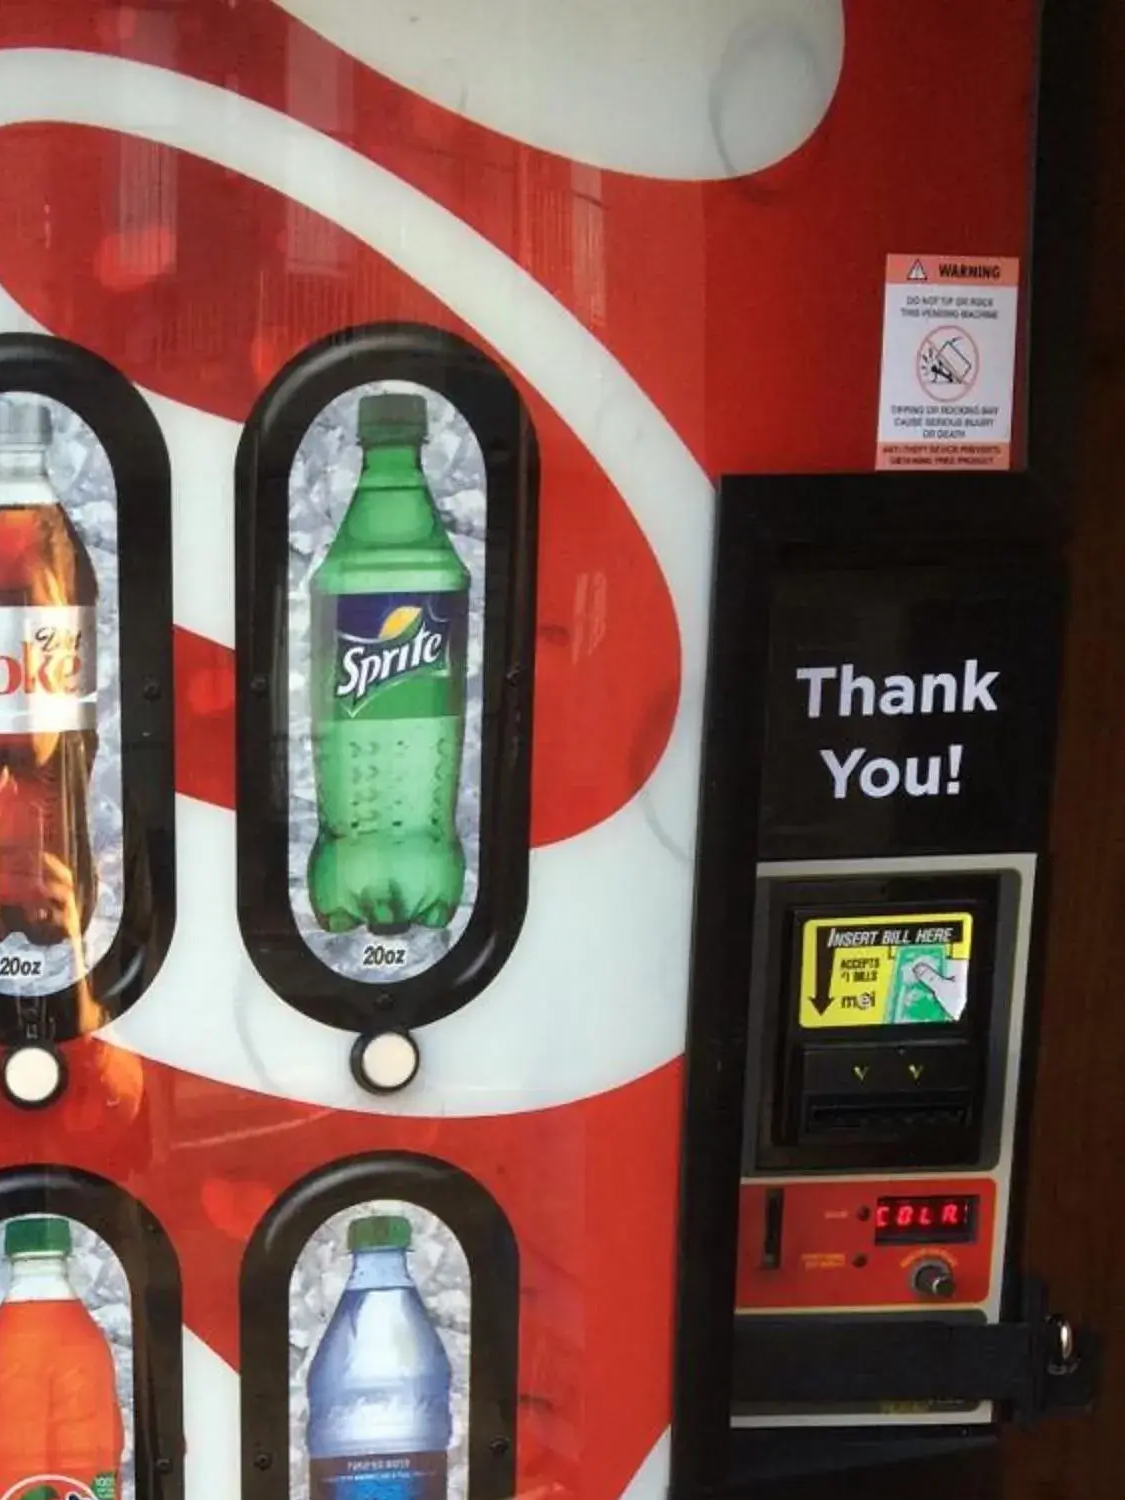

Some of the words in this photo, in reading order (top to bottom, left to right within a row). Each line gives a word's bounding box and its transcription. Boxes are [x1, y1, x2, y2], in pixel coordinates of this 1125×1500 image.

[938, 263, 1001, 279] WARNING
[336, 621, 442, 698] Sprite
[796, 657, 1001, 718] Thank
[819, 744, 963, 799] You!
[362, 944, 406, 965] 20oz
[827, 928, 879, 948] INSERT
[882, 930, 913, 944] BILL
[915, 927, 955, 943] HERE
